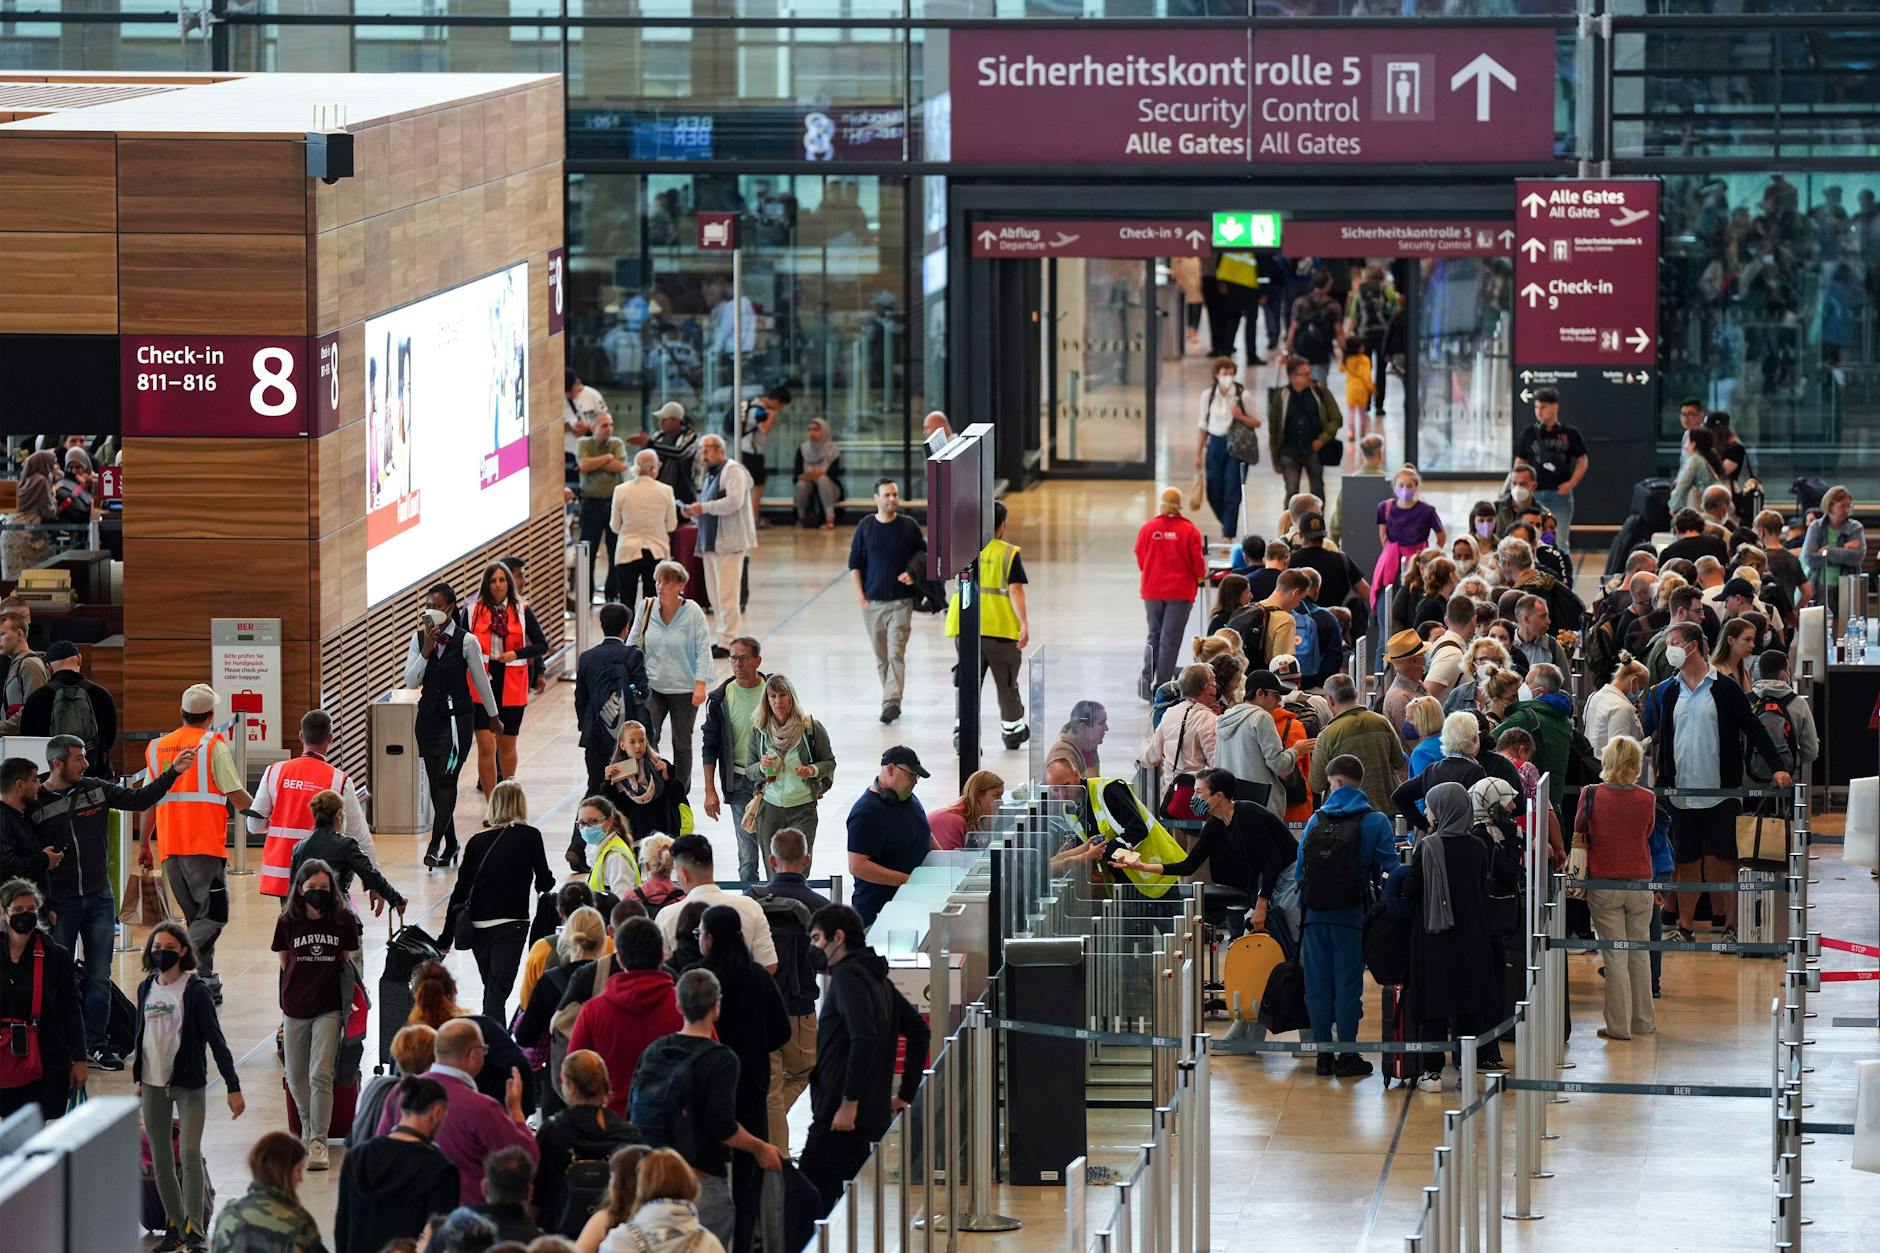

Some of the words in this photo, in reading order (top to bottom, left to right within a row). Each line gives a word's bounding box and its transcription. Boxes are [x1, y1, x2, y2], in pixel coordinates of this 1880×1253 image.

[977, 55, 1333, 88] Sicherheitskontrolle
[1341, 56, 1361, 87] 5
[1137, 97, 1246, 129] Security
[1261, 97, 1360, 123] Control
[1125, 133, 1173, 155] Alle
[1178, 133, 1244, 155] Gates
[1259, 133, 1291, 155] All
[1297, 133, 1362, 155] Gates
[1549, 189, 1580, 205] Alle
[1583, 190, 1625, 206] Gates
[1548, 206, 1567, 219] All
[1567, 206, 1601, 219] Gates
[999, 227, 1041, 241] Abflug
[1119, 227, 1172, 240] Check-in
[1173, 227, 1183, 239] 9
[1340, 226, 1461, 239] Sicherheitskontrolle
[1463, 226, 1472, 239] 5
[999, 240, 1046, 251] Departure
[1398, 240, 1436, 251] Security
[1437, 240, 1472, 250] Control
[555, 255, 563, 316] 8
[1548, 278, 1614, 294] Check-in
[1548, 296, 1560, 310] 9
[137, 345, 224, 364] Check-in
[249, 347, 298, 417] 8
[330, 341, 339, 411] 8
[237, 623, 254, 631] BER
[283, 778, 304, 791] BER
[1663, 788, 1678, 797] BER
[1748, 789, 1763, 798] BER
[1288, 821, 1303, 829] BER
[1648, 882, 1663, 890] BER
[1739, 883, 1755, 891] BER
[293, 933, 340, 949] HARVARD
[1613, 941, 1630, 949] BER
[1711, 943, 1728, 951] BER
[1850, 944, 1867, 954] STOP
[1857, 972, 1873, 980] STOP
[1000, 1020, 1013, 1029] BER
[1075, 1029, 1089, 1039] BER
[1152, 1037, 1165, 1046] BER
[1300, 1042, 1318, 1051] BER
[1405, 1042, 1423, 1052] BER
[1564, 1083, 1582, 1092] BER
[1673, 1086, 1691, 1095] BER
